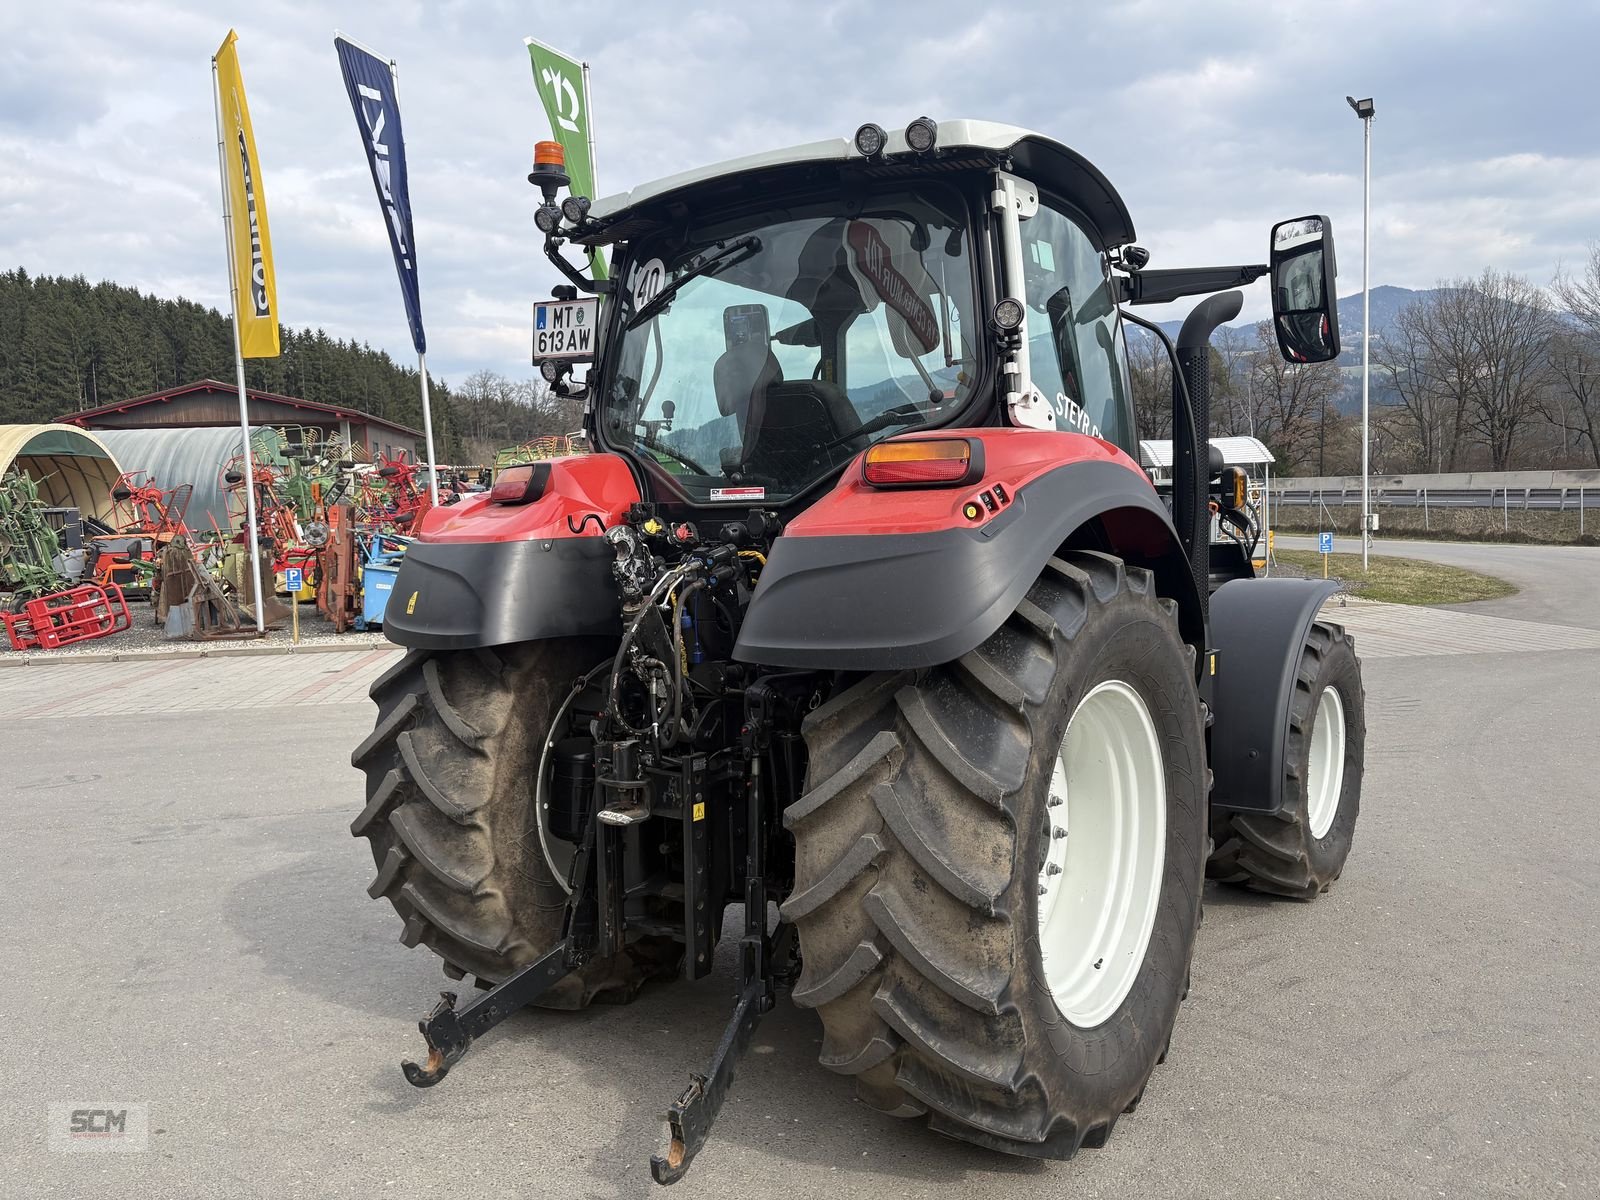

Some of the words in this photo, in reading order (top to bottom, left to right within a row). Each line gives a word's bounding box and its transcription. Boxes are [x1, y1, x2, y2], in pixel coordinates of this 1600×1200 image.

[637, 267, 660, 306] 40
[553, 306, 573, 329] MT
[538, 329, 564, 353] 613
[566, 327, 591, 351] AW
[1056, 391, 1090, 436] STEYR
[1322, 534, 1330, 544] P
[290, 570, 298, 581] P
